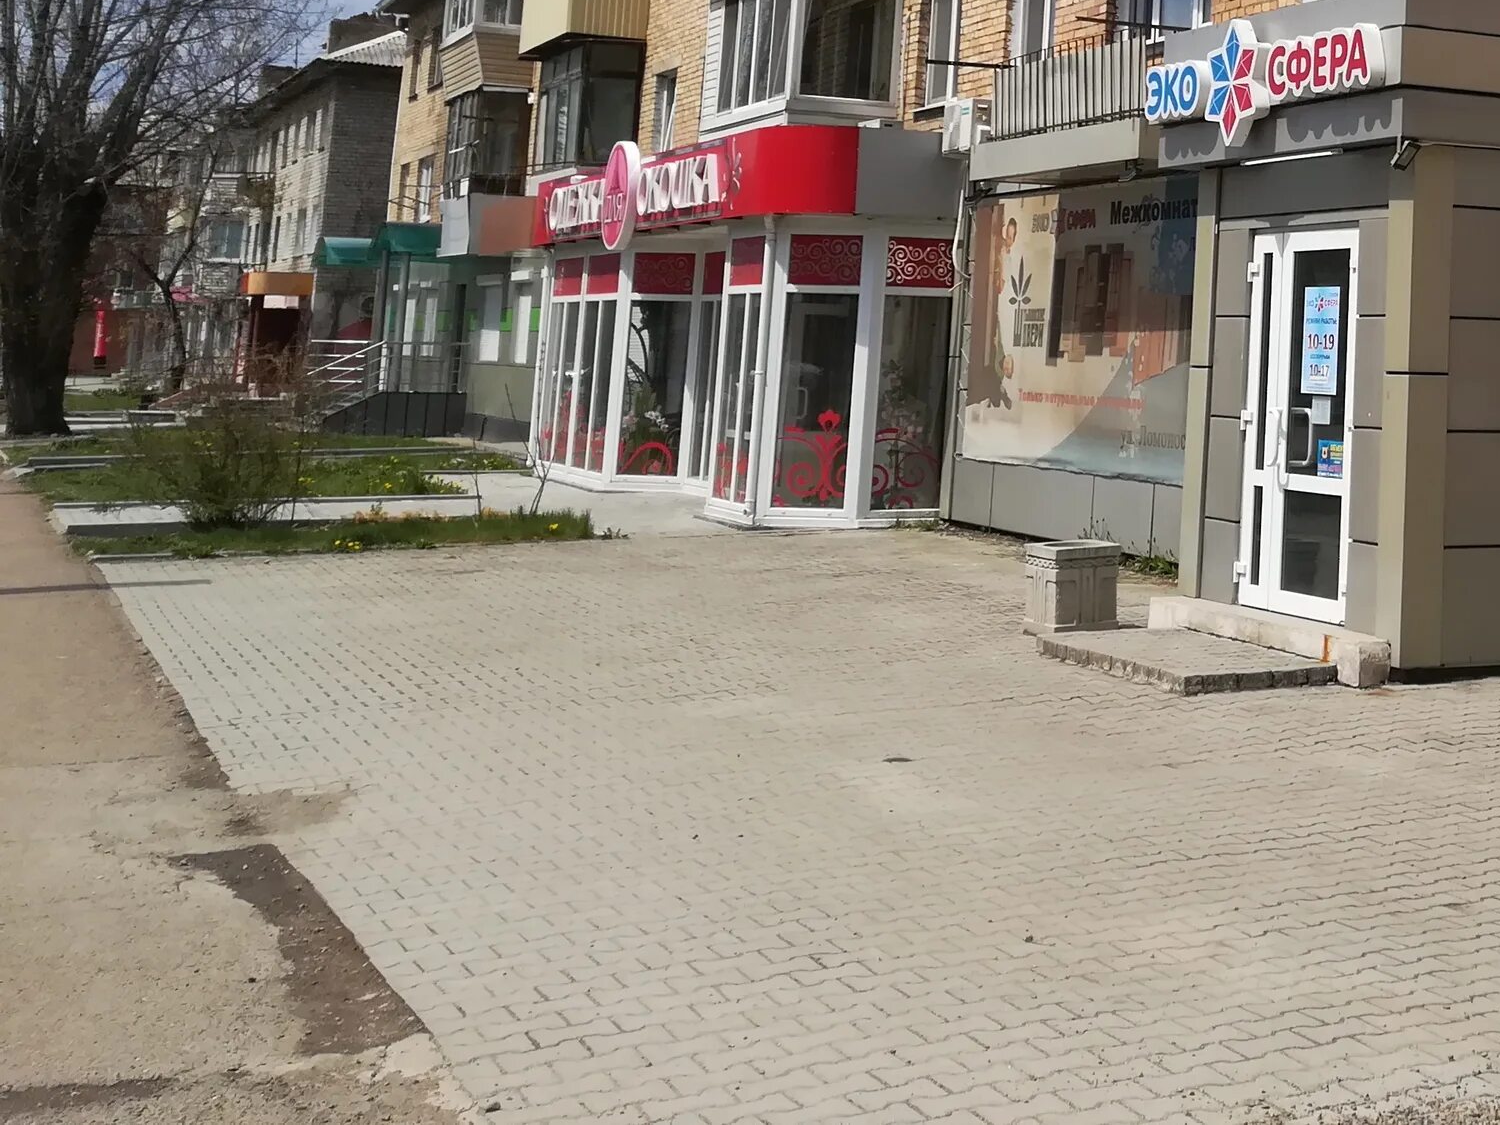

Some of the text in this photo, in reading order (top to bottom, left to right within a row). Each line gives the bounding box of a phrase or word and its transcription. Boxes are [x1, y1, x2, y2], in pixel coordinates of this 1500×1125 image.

[1146, 28, 1369, 117] ЭКО СФЕРА
[636, 153, 720, 217] ОКОШКА
[1307, 333, 1335, 350] 10-19
[1309, 364, 1330, 377] 10-17
